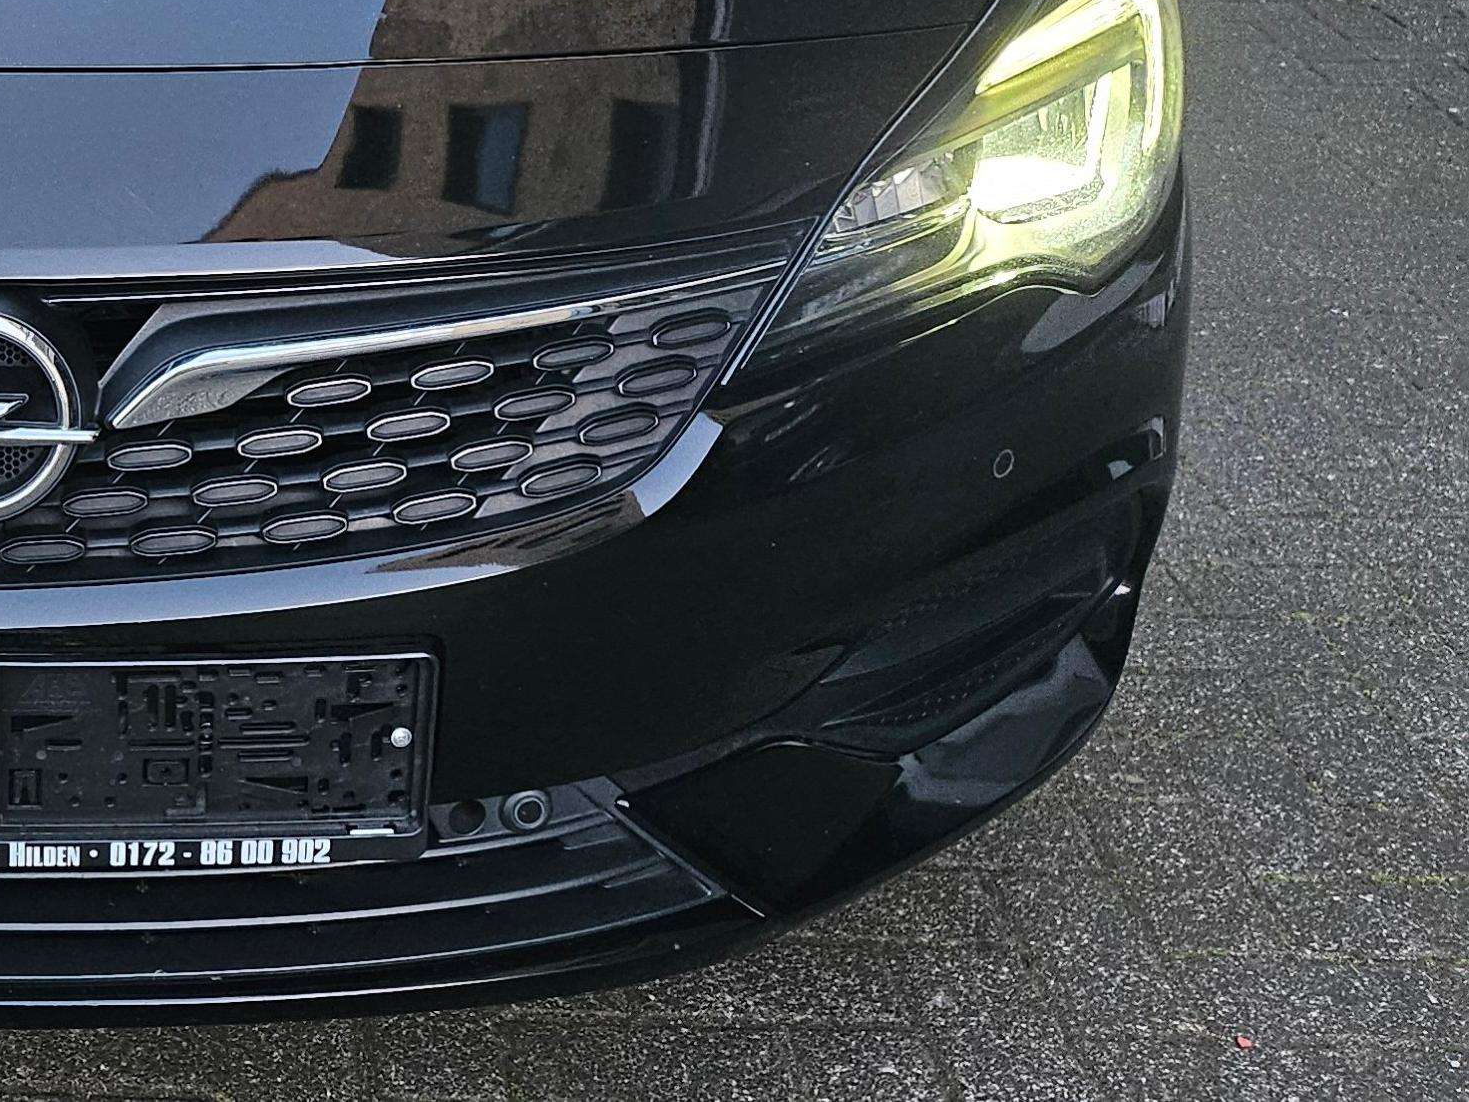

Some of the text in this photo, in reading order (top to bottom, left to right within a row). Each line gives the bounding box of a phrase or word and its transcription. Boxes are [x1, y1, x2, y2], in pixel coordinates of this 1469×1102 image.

[8, 841, 81, 867] HILDEN
[109, 841, 176, 866] 0172
[200, 839, 233, 865] 86
[240, 839, 274, 864] 00
[281, 838, 331, 864] 902
